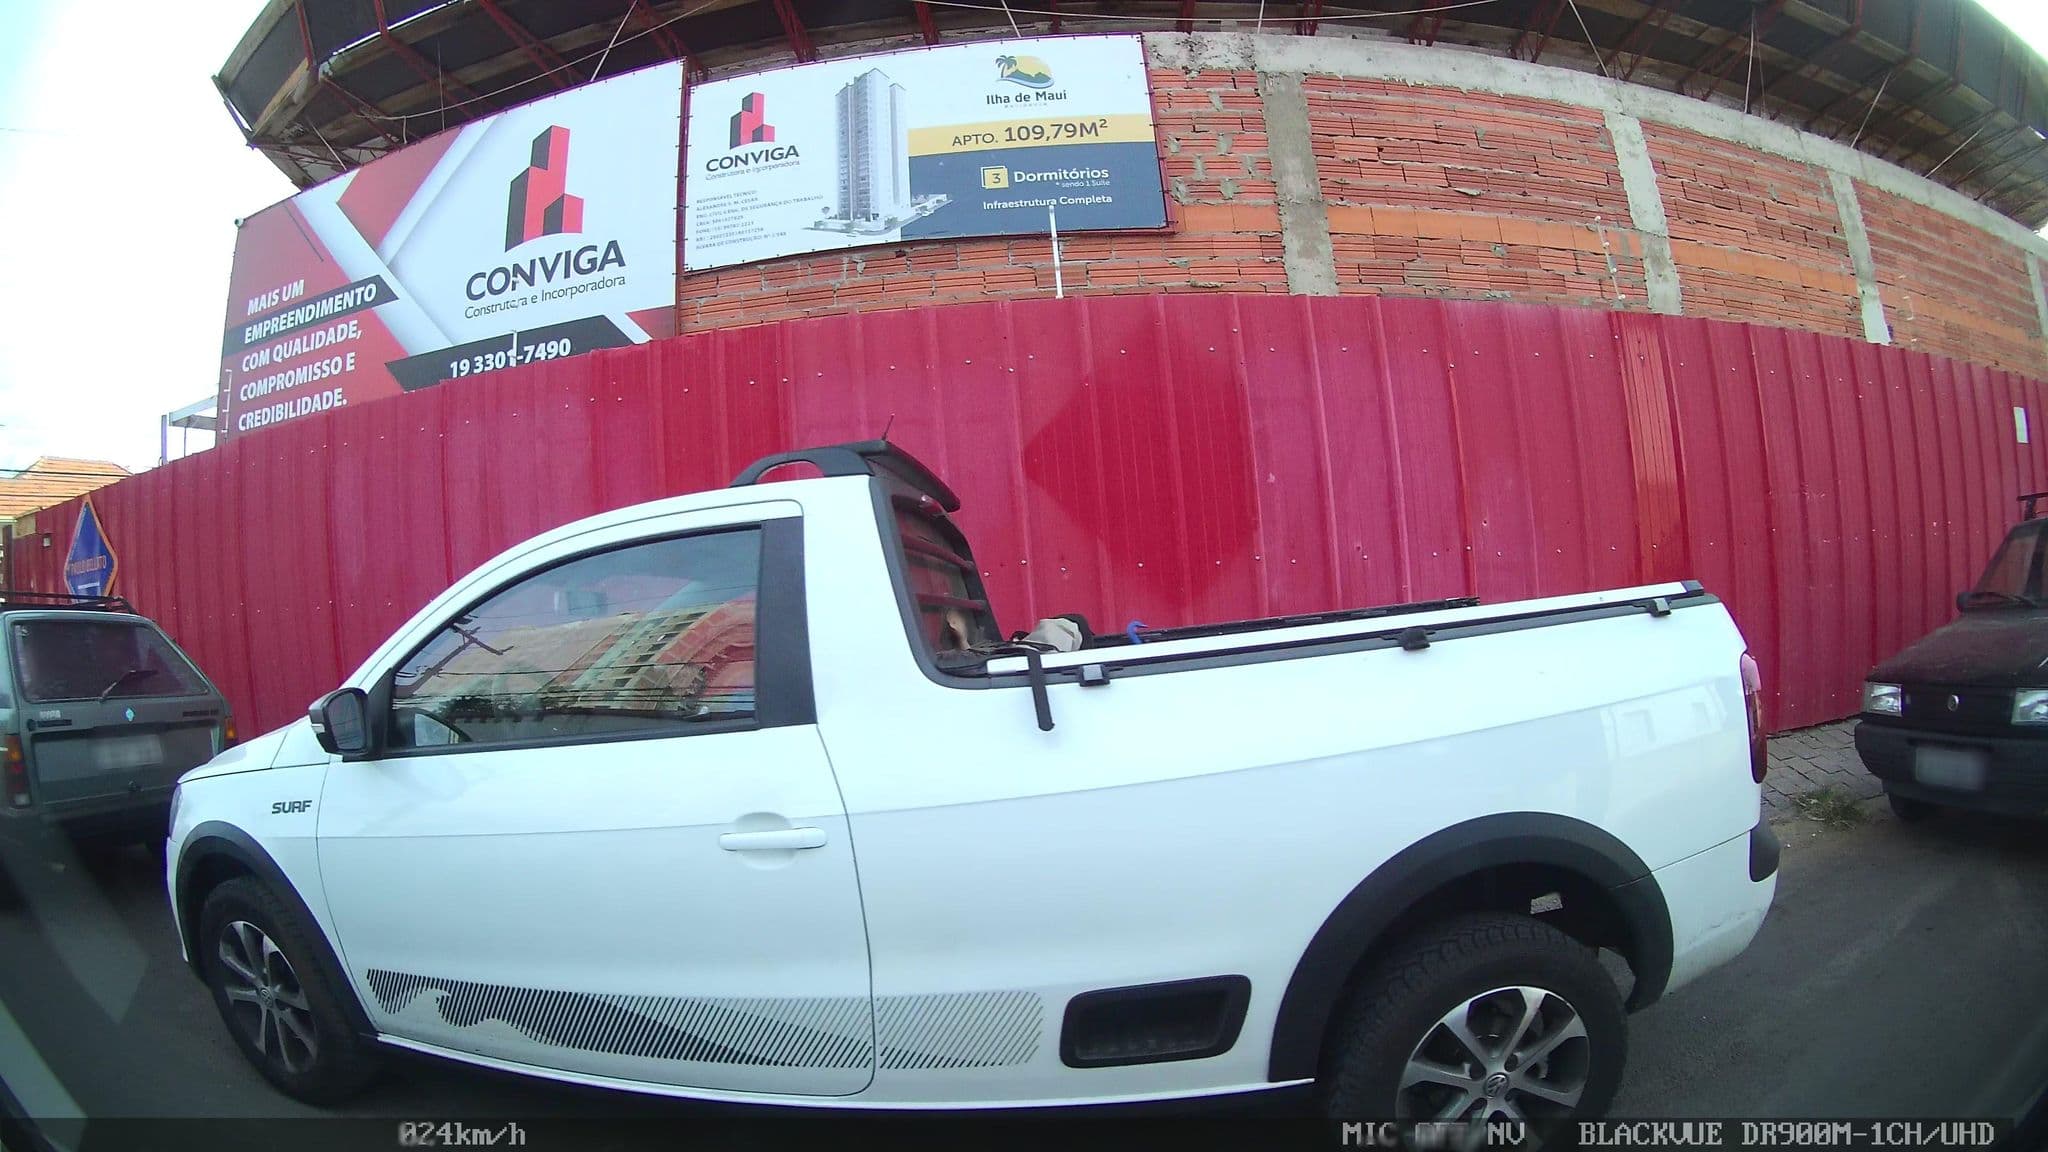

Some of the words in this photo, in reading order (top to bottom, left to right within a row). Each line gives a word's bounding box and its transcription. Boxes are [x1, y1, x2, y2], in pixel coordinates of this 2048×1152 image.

[986, 94, 1010, 105] Ilha
[1014, 92, 1031, 103] de
[1036, 90, 1067, 101] Maui
[705, 145, 800, 172] CONVIGA
[952, 133, 999, 147] APTO.
[991, 173, 1001, 184] 3
[1013, 167, 1109, 183] Dormitórios
[983, 198, 1057, 210] Infraestrutura
[1059, 195, 1113, 206] Completa
[465, 239, 626, 301] CONVIGA
[244, 283, 378, 344] EMPREENDIMENTO
[247, 288, 280, 316] MAIS
[282, 279, 305, 302] UM
[465, 297, 528, 319] Construtora
[531, 294, 538, 303] e
[541, 276, 626, 301] Incorporadora
[242, 352, 270, 372] COM
[273, 320, 362, 363] QUALIDADE,
[449, 358, 470, 378] 19
[473, 338, 572, 374] 3301-7490
[240, 356, 342, 401] COMPROMISSO
[345, 352, 356, 371] E
[238, 387, 347, 431] CREDIBILIDADE.
[271, 800, 312, 814] SURF
